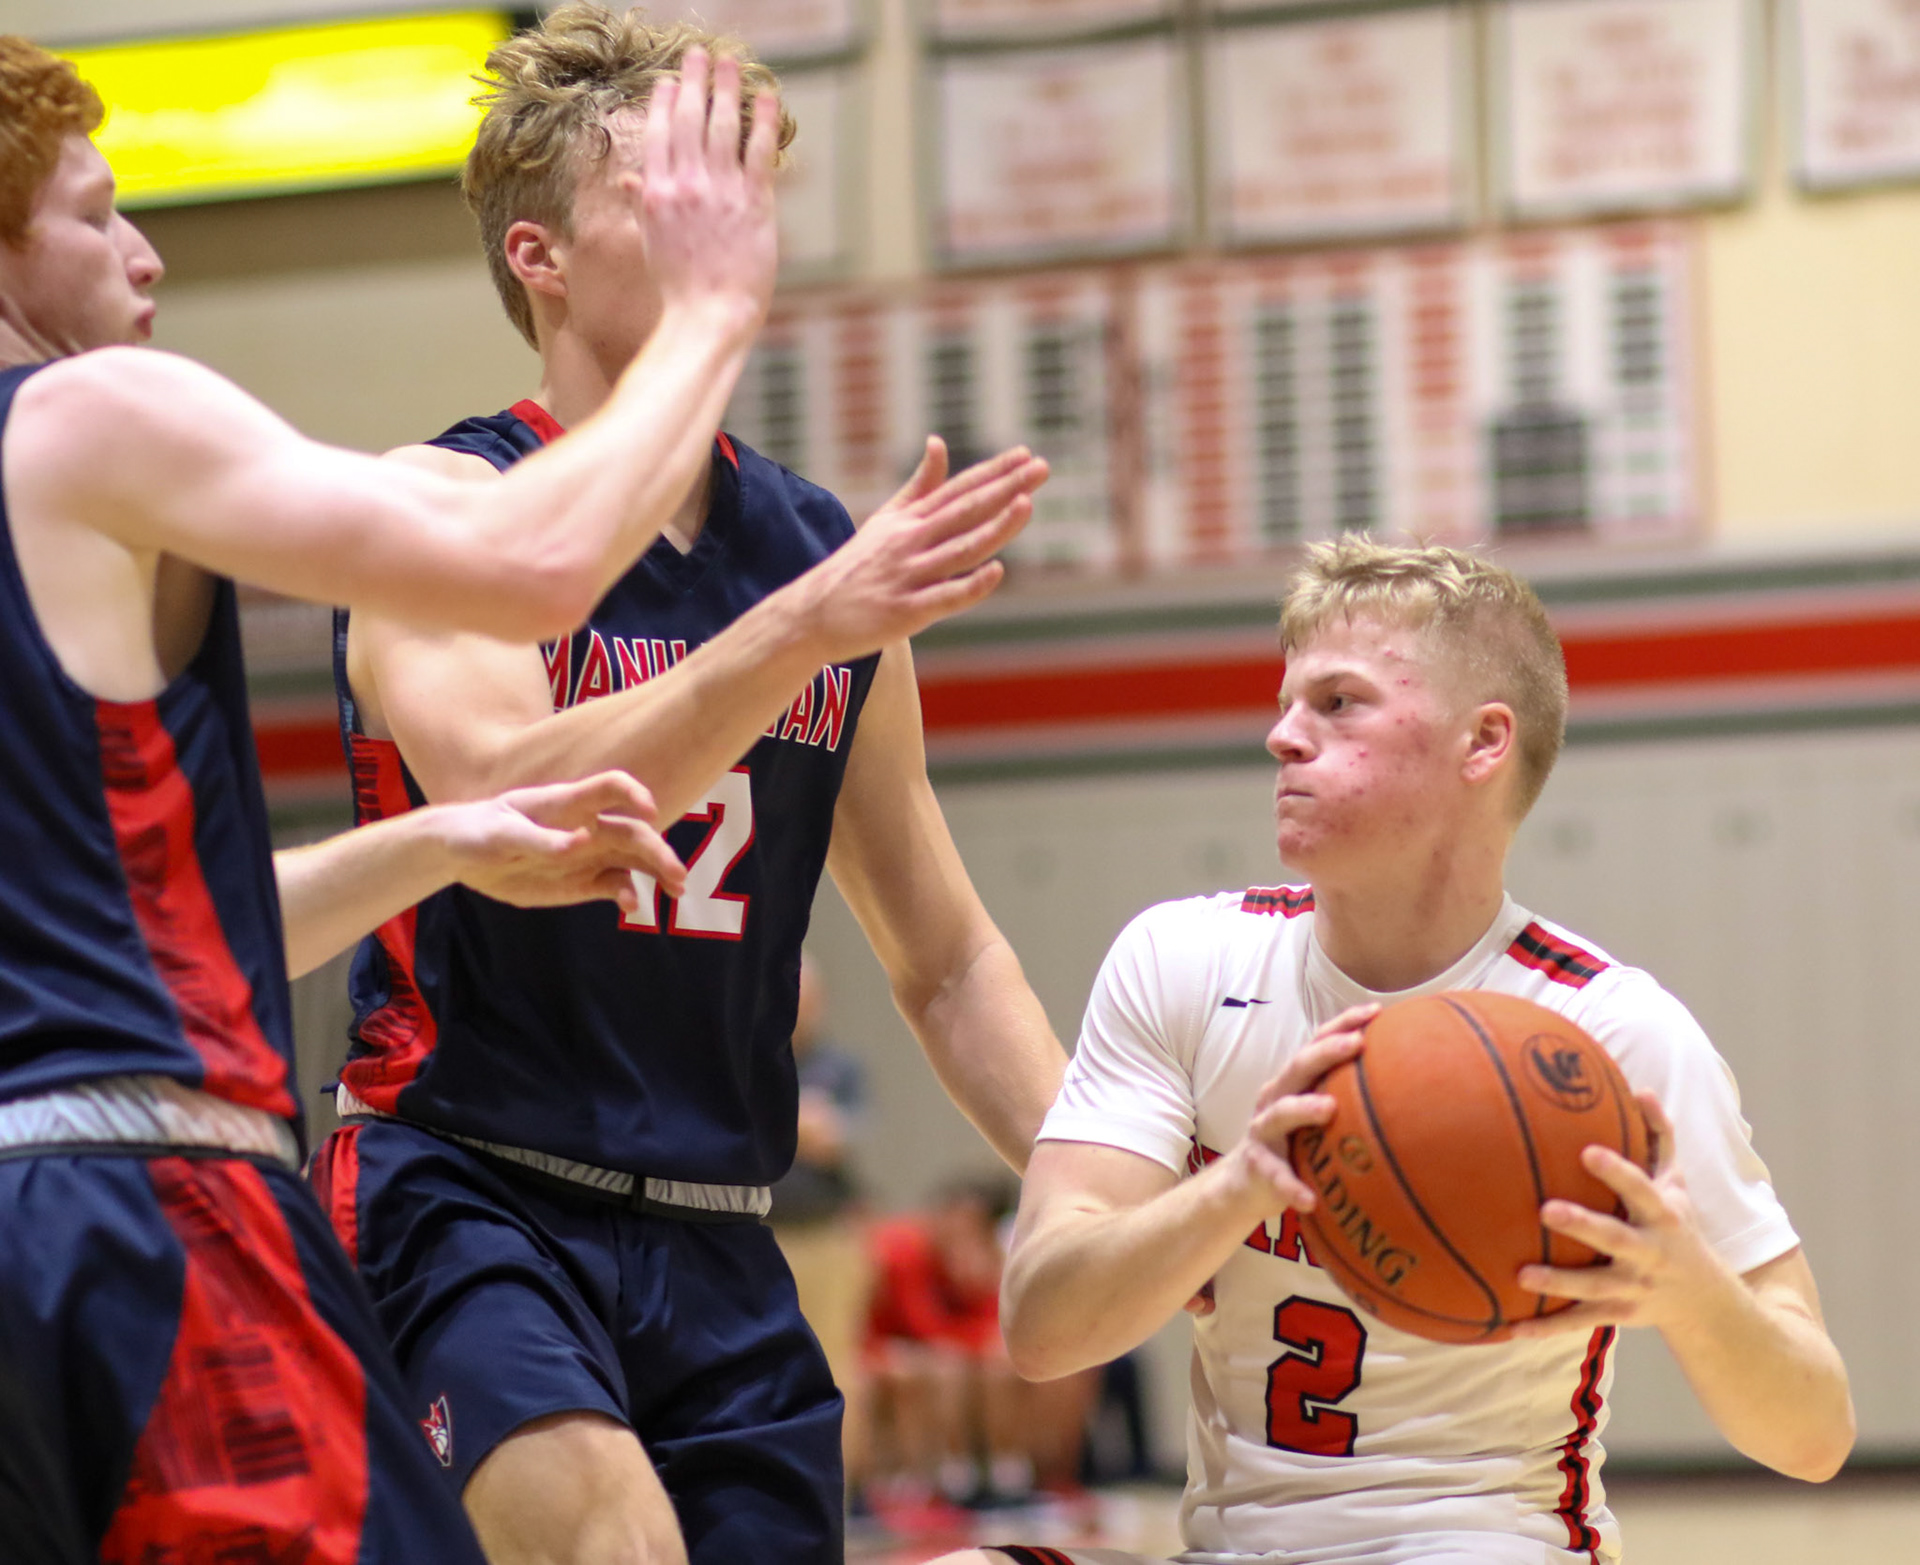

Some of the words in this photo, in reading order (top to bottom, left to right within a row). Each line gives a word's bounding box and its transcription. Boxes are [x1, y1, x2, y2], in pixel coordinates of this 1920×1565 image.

[545, 629, 852, 752] MANAN
[1302, 1126, 1417, 1286] ALDING
[1265, 1294, 1368, 1457] 2
